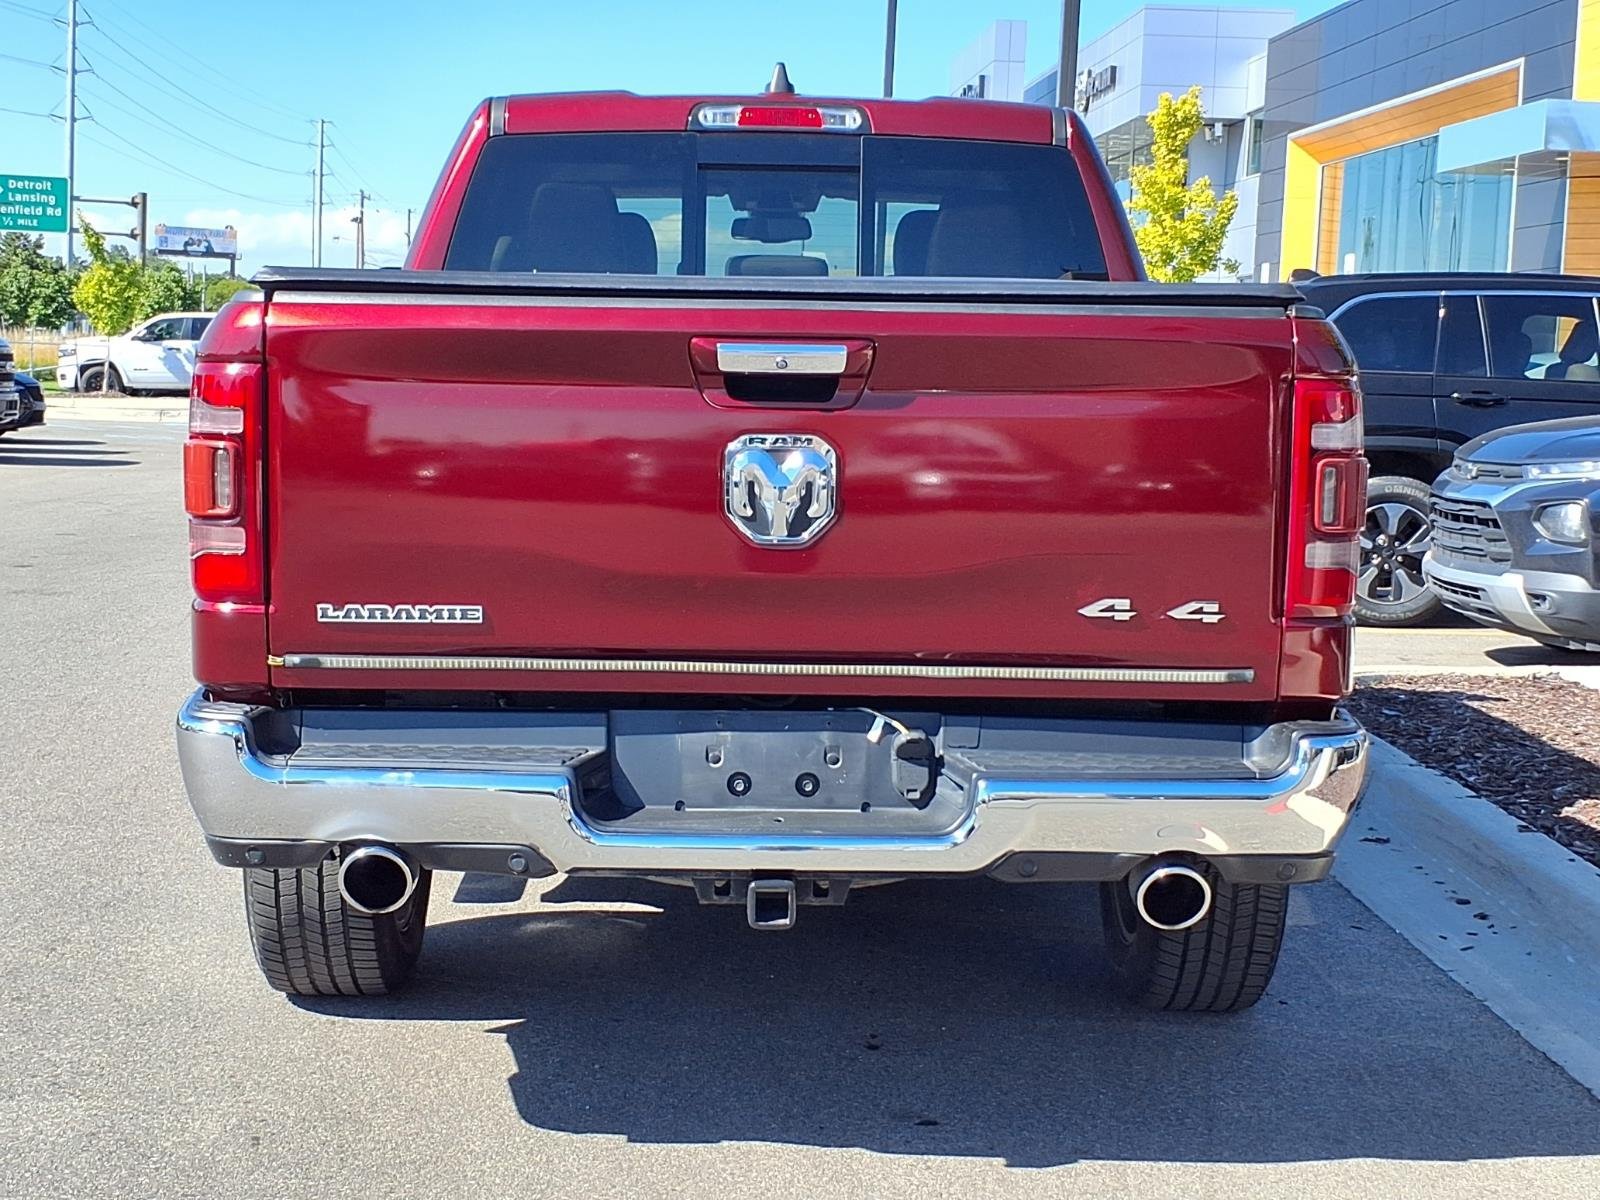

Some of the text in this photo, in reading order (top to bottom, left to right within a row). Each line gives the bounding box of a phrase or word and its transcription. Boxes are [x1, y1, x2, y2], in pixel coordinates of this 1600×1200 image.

[8, 179, 52, 191] Detroit
[8, 192, 56, 206] Lansing
[0, 205, 62, 217] enfield Rd
[17, 218, 39, 226] MILE
[747, 436, 814, 446] RAM
[316, 603, 483, 623] LARAMIE
[1077, 598, 1226, 623] 4 4
